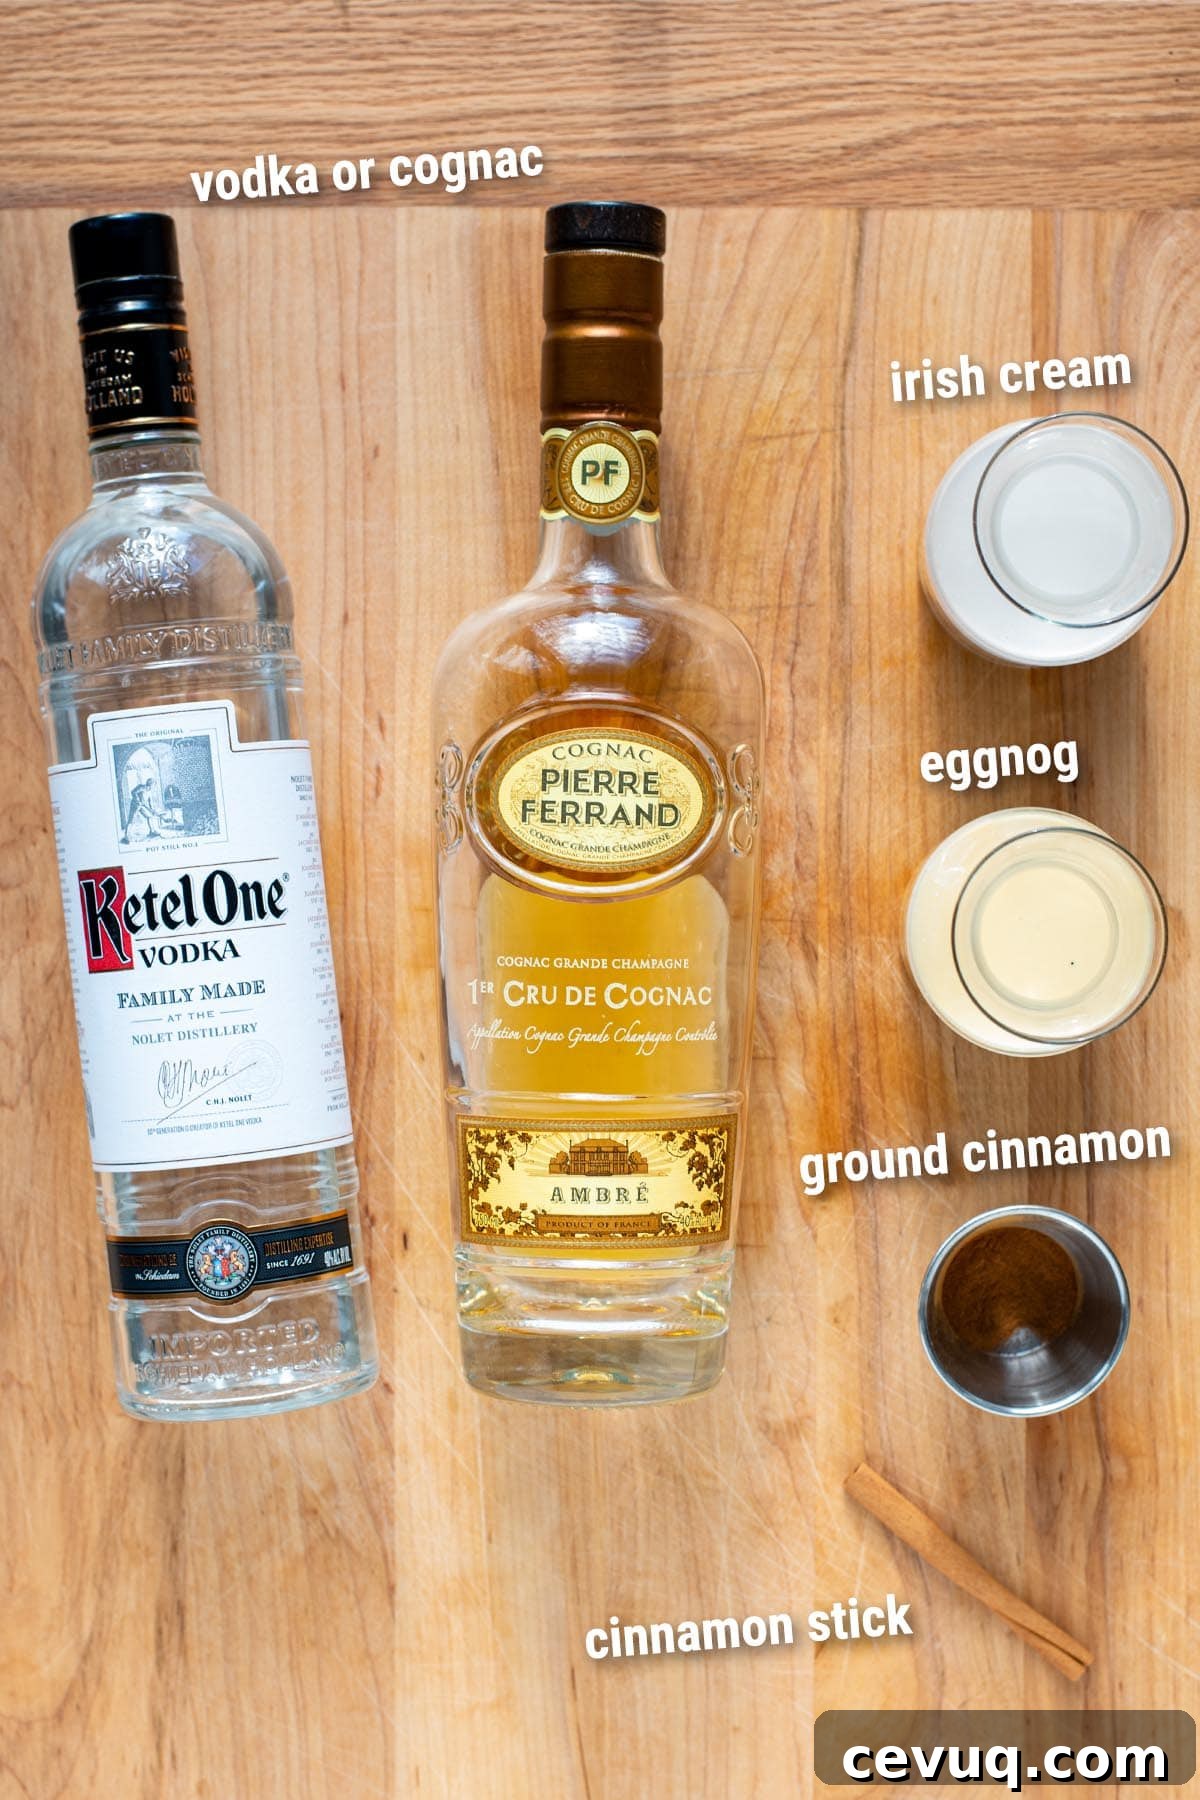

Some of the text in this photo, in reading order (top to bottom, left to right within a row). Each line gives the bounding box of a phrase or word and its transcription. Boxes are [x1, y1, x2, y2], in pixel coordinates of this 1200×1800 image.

[581, 460, 619, 486] PF
[150, 728, 184, 737] ORIGINAL
[552, 743, 654, 764] COGNAC
[541, 768, 661, 796] PIERRE
[521, 799, 681, 828] FERRAND
[529, 829, 671, 854] COGNAC GRANDE CHAMPAGNE
[80, 874, 199, 965] Ketel
[139, 938, 240, 969] VODKA
[497, 955, 690, 969] COGNAC GRANDE CHAMPAGNE
[117, 979, 266, 1009] FAMILY MADE
[565, 986, 597, 1006] DE
[604, 982, 712, 1010] COGNAC
[167, 1010, 215, 1023] AT THE
[132, 1022, 258, 1046] NOLET DISTILLERY
[524, 1026, 564, 1054] Cognac
[568, 1022, 613, 1048] Grande
[614, 1020, 672, 1055] Champagne
[228, 1094, 253, 1104] NOLET
[545, 1221, 651, 1229] PRODUCT OF FRANCE
[263, 1238, 304, 1257] DISTILLING
[266, 1259, 289, 1270] SINCE
[290, 1251, 316, 1267] 1691
[149, 1318, 320, 1360] IMPORTED
